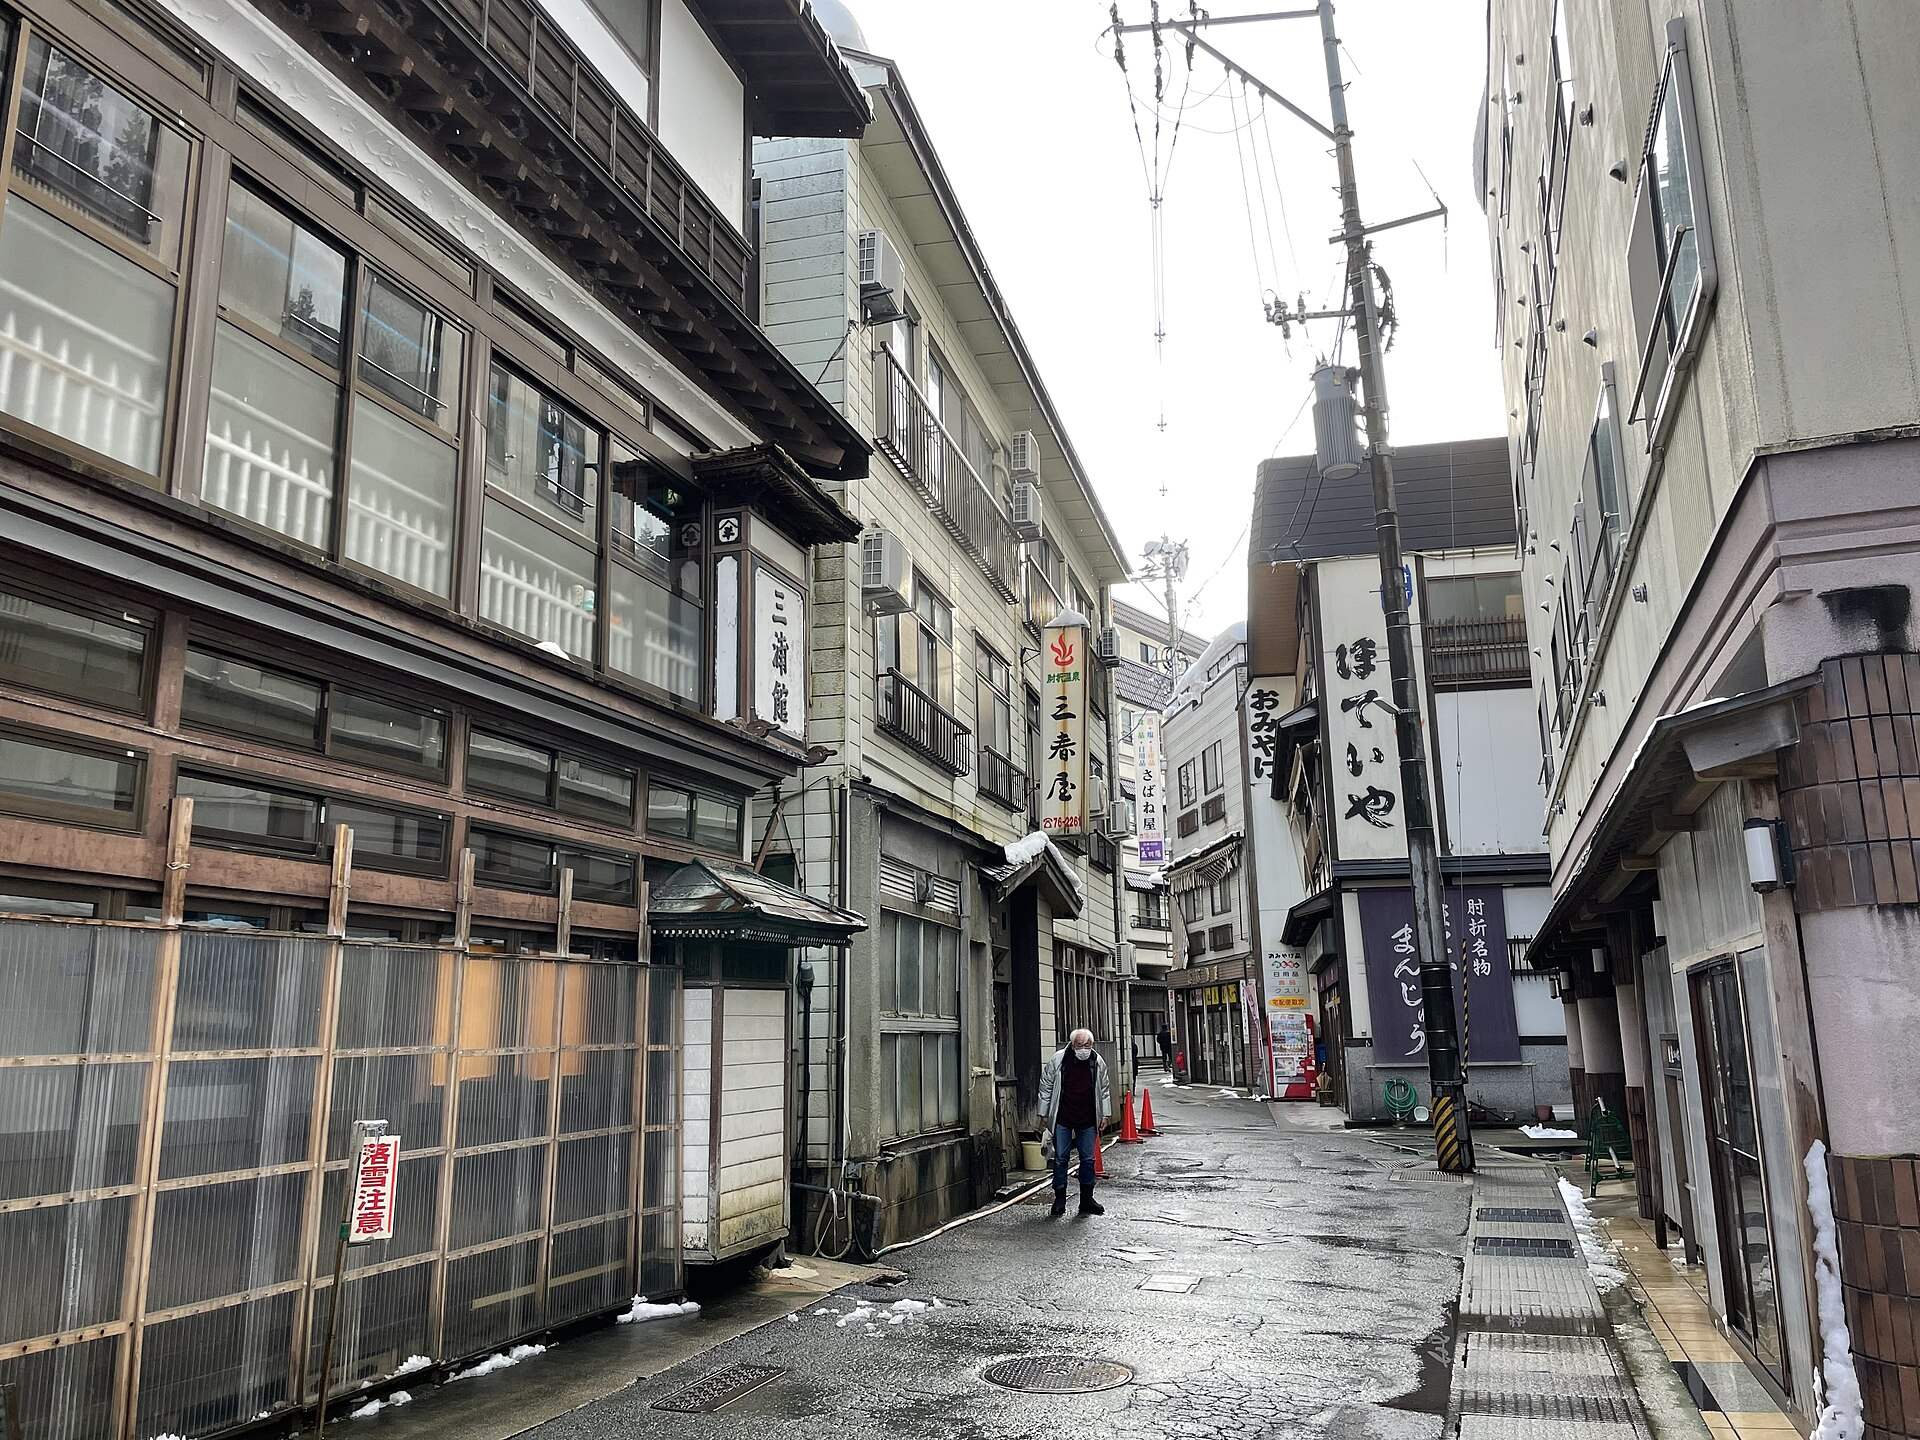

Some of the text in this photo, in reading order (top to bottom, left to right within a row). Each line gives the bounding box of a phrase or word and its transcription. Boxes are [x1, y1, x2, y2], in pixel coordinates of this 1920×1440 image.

[771, 588, 790, 725] 三浦館
[1046, 695, 1077, 803] 三春屋
[1335, 636, 1396, 830] ほていや
[1142, 768, 1157, 831] さばね屋
[1466, 897, 1492, 977] 肘折名物
[355, 1142, 391, 1234] 落雪注意
